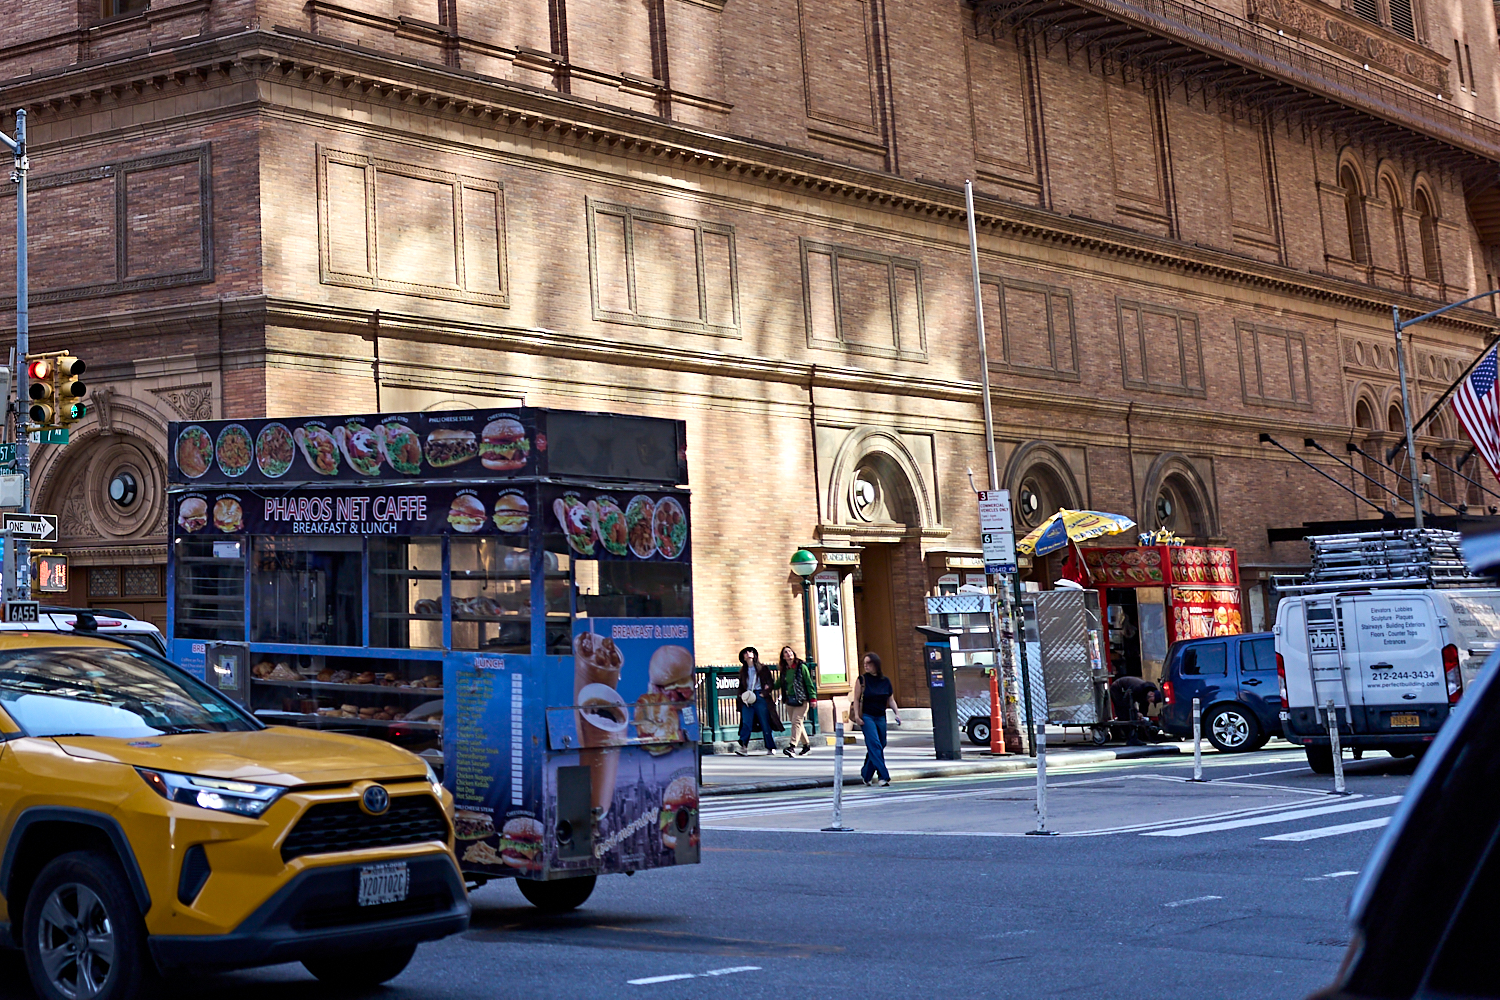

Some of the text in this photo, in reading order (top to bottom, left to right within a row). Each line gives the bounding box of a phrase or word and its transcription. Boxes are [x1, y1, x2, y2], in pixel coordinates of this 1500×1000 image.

[487, 412, 521, 421] CHEESEBURGER
[0, 446, 9, 460] 57
[980, 492, 986, 500] 3
[264, 496, 427, 521] PHAROS NET CAFFE
[9, 522, 46, 532] ONE WAY
[293, 522, 397, 534] BREAKFAST & LUNCH
[984, 534, 991, 543] 6
[11, 606, 36, 621] 6A55
[612, 625, 688, 638] BREAKFAST & LUNCH
[474, 657, 505, 670] LUNCH
[1372, 671, 1435, 681] 212-244-3434
[716, 676, 740, 689] Subwa
[475, 774, 494, 782] Nuggets
[465, 793, 484, 802] Sausage
[615, 806, 659, 843] morning
[363, 873, 404, 897] Y207102C
